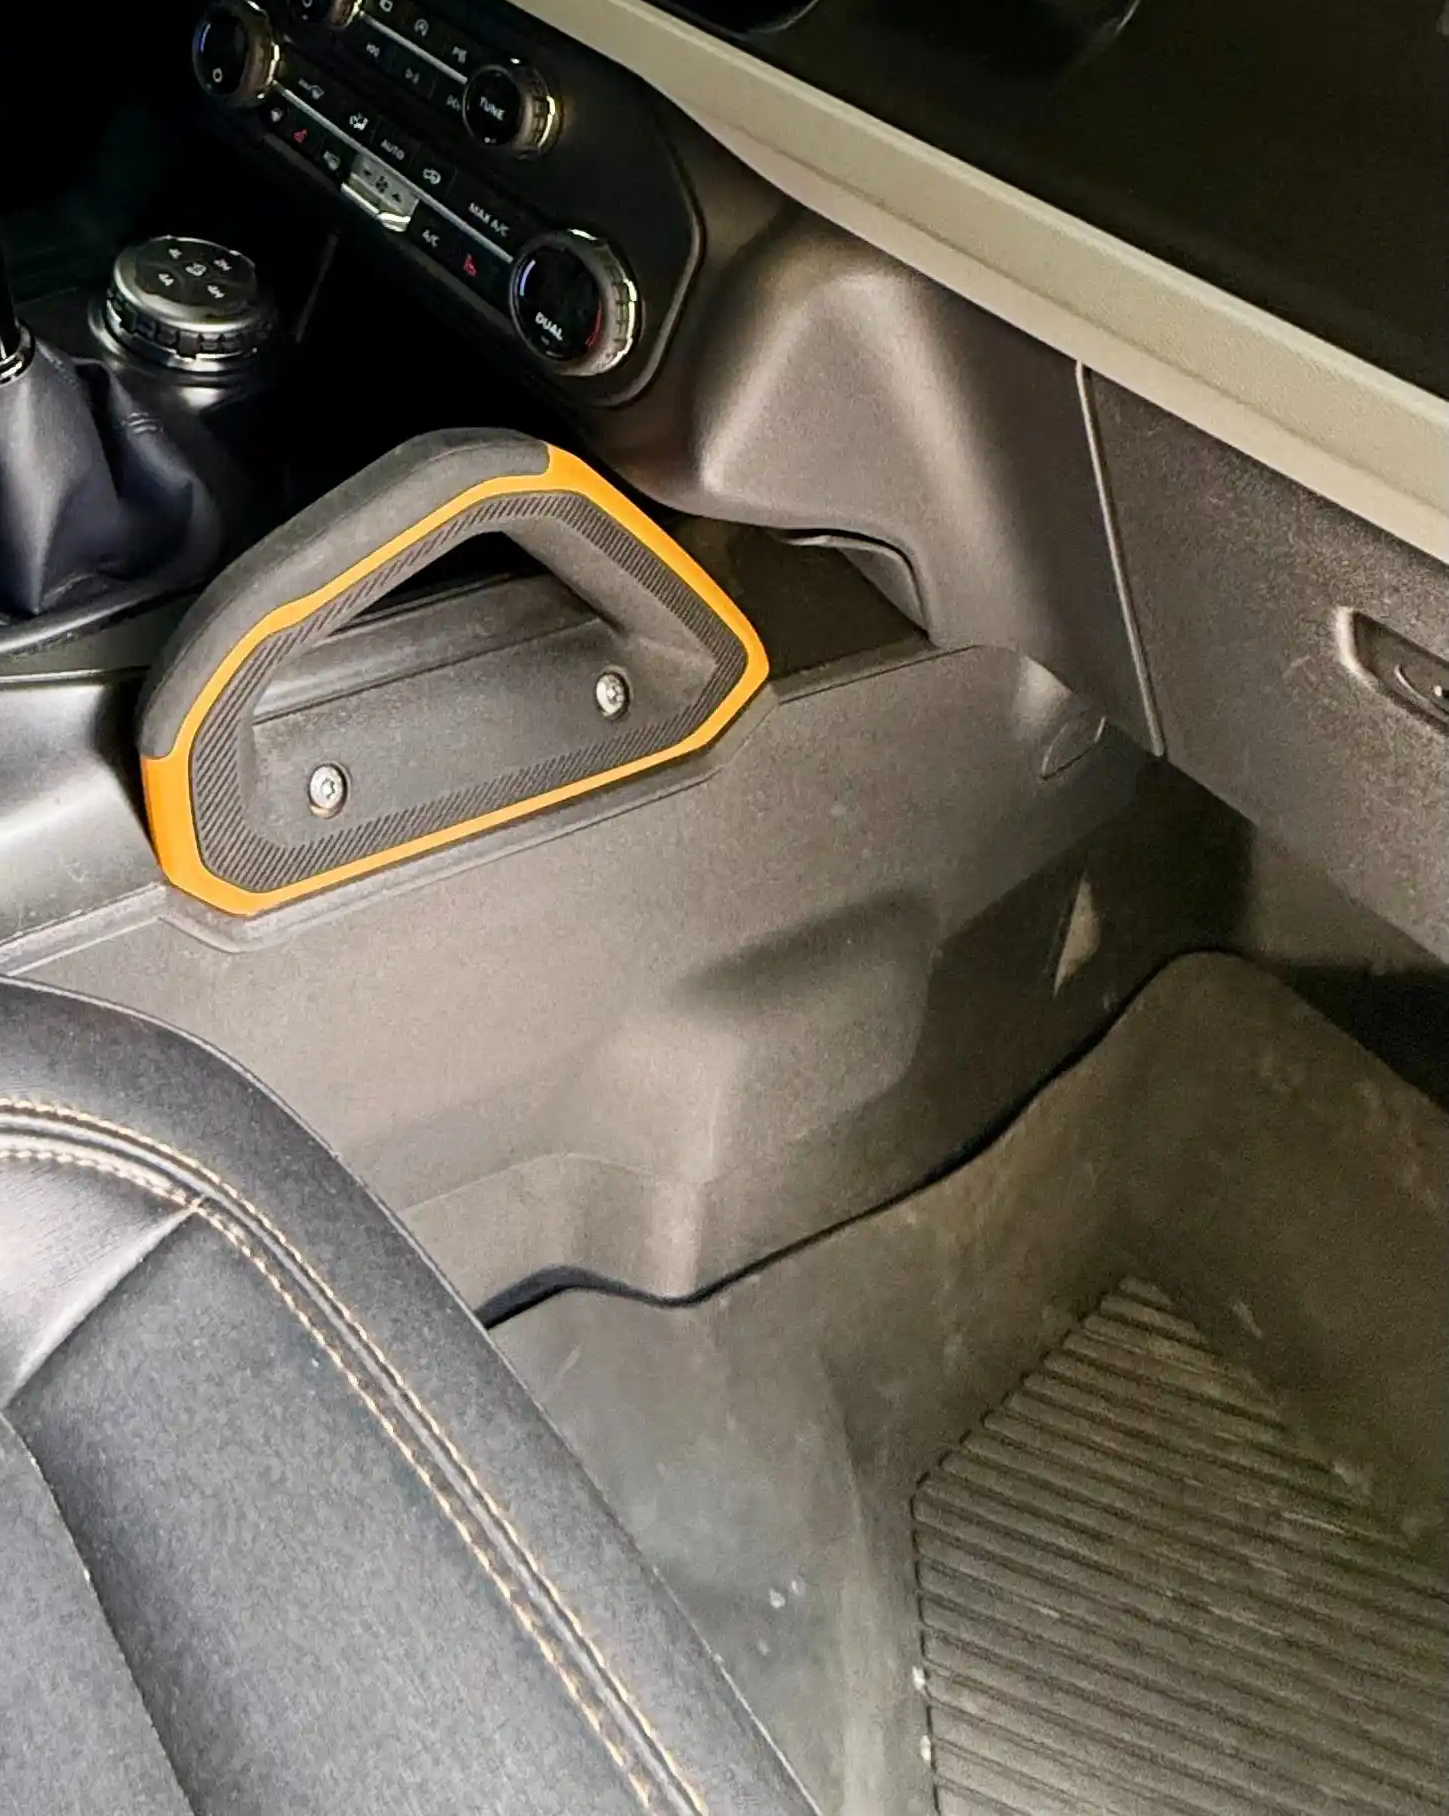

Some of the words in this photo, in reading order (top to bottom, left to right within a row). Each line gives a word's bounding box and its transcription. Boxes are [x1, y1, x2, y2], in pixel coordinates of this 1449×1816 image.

[480, 96, 505, 122] TUNE
[380, 139, 405, 161] AUTO
[468, 202, 492, 225] MAX
[490, 218, 510, 238] A/C
[421, 229, 441, 248] A/C
[535, 311, 564, 341] DUAL
